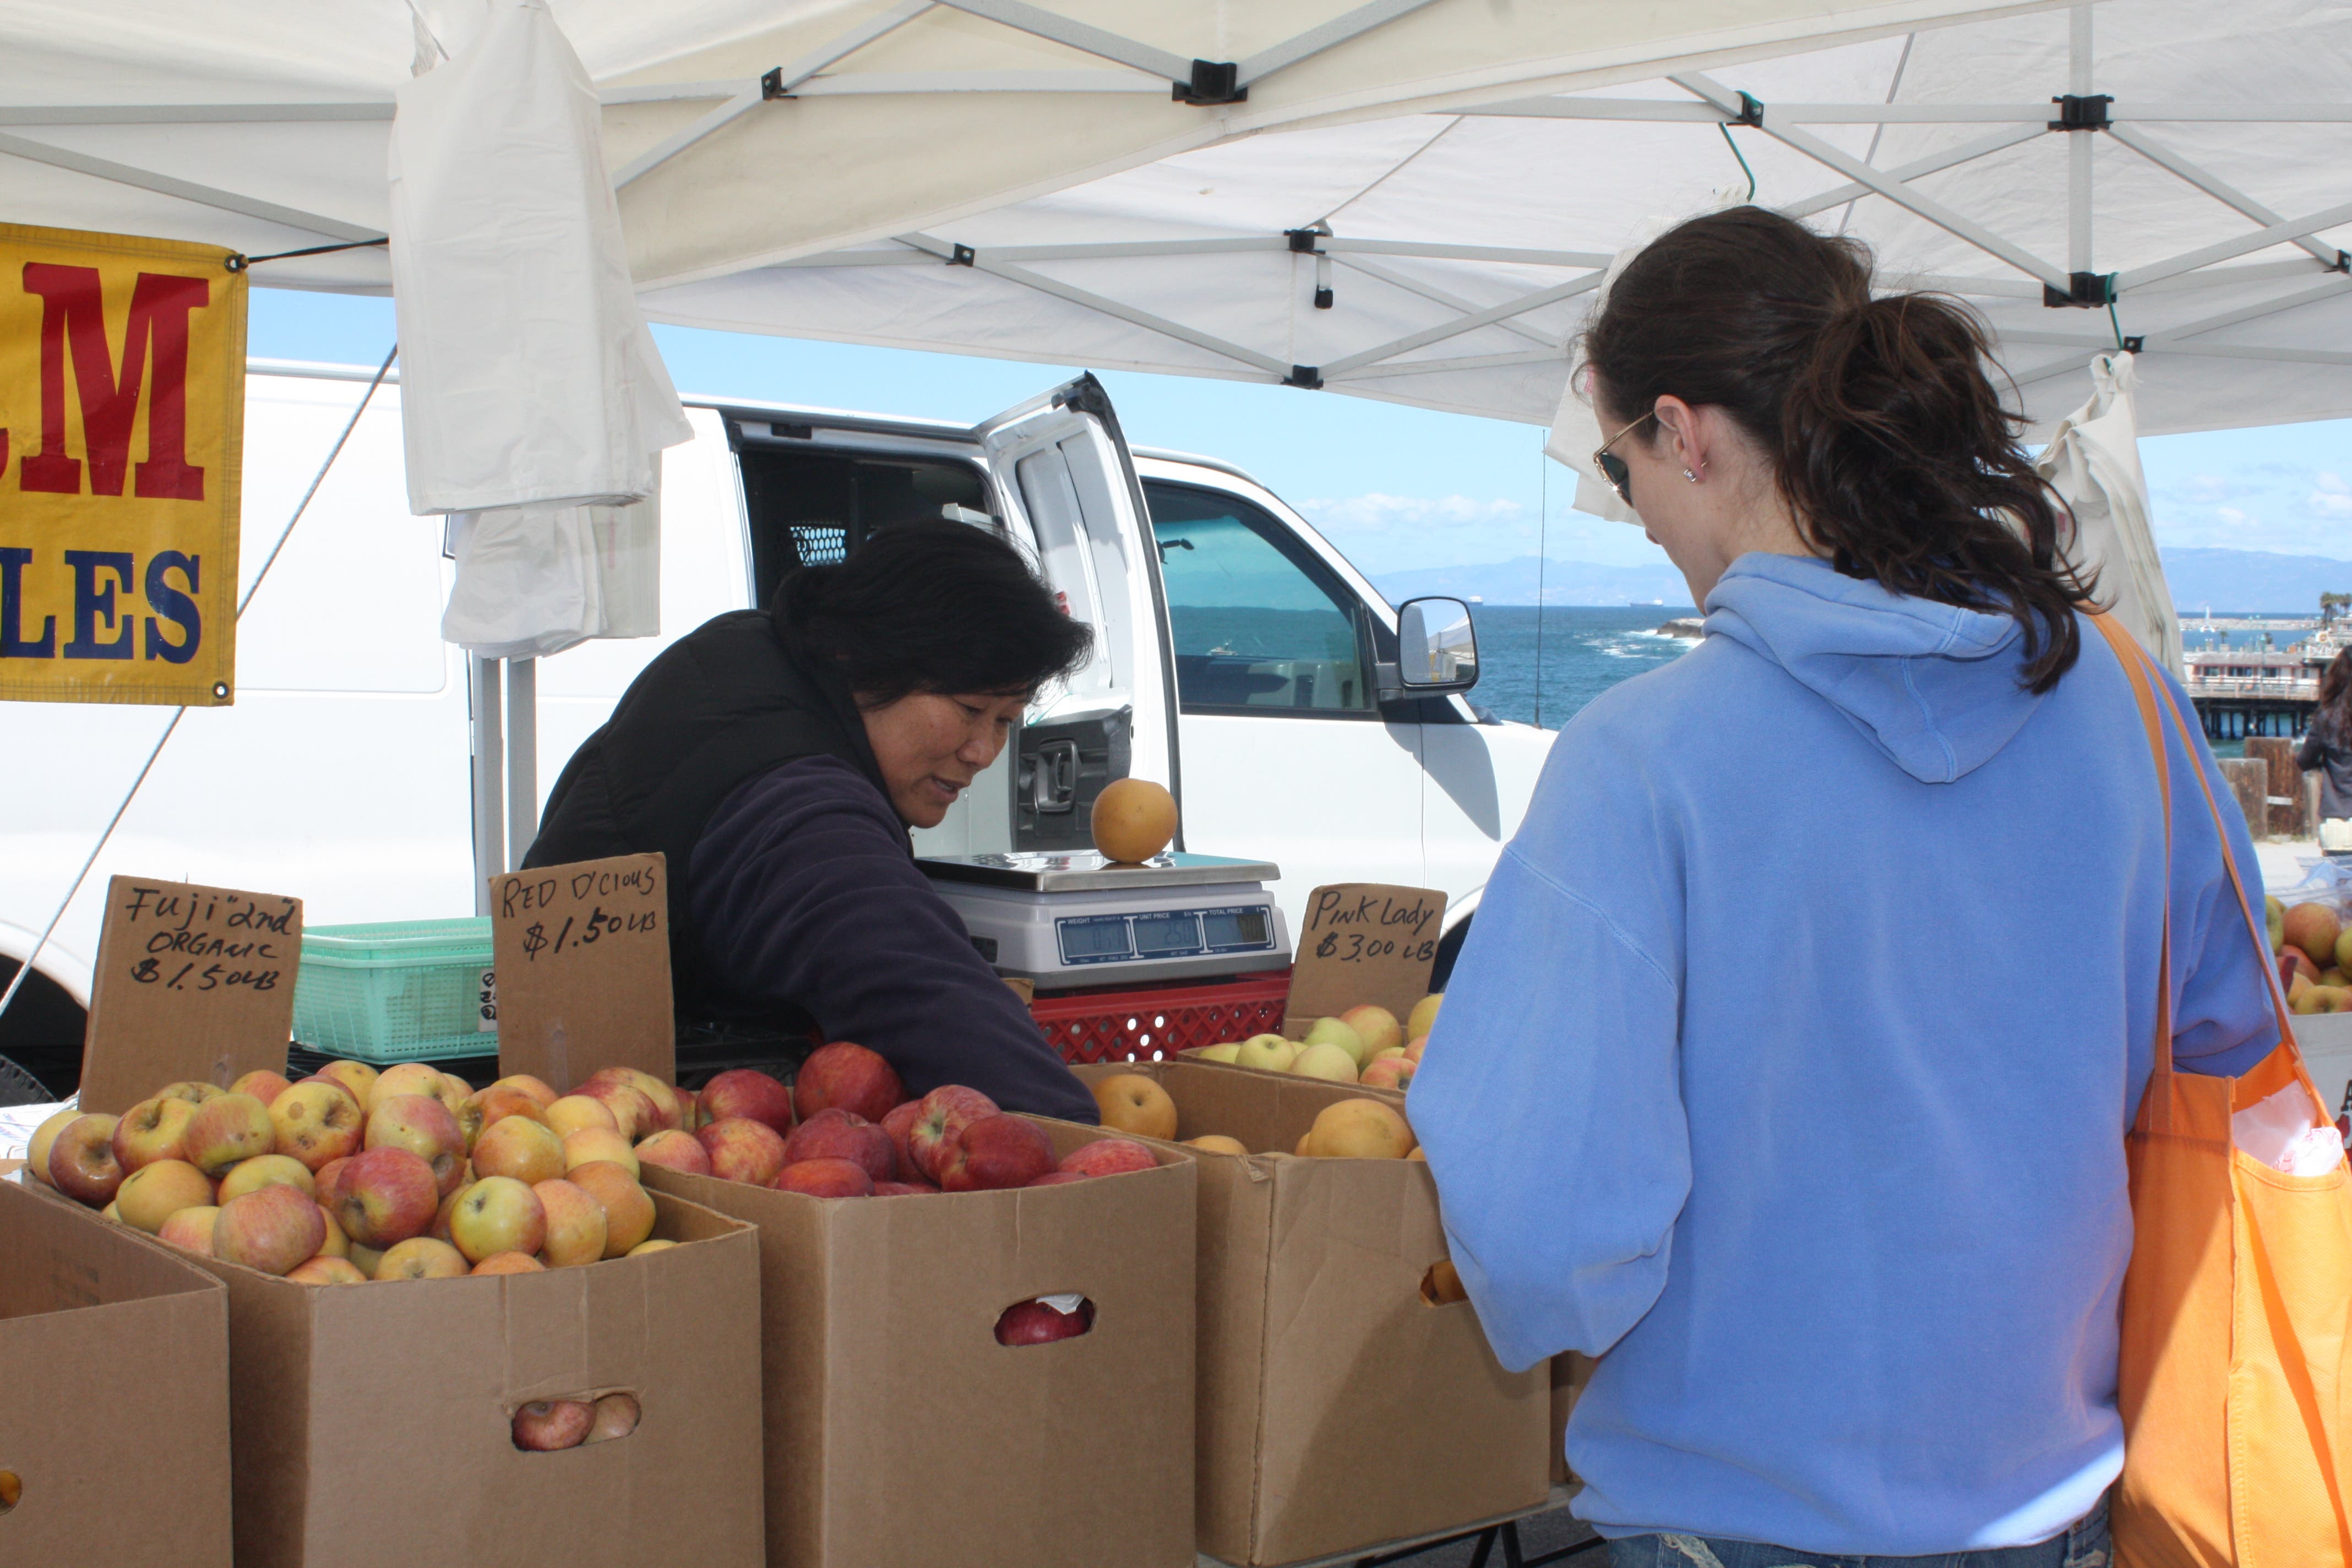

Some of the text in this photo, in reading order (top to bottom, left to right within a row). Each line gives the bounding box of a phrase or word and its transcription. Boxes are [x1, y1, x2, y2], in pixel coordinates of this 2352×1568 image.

[0, 262, 210, 502] M
[126, 887, 219, 931] Fuji
[503, 878, 557, 918] RED
[1380, 897, 1434, 936] Lady
[524, 907, 622, 961] $1.50
[1067, 917, 1091, 925] WEIGHT
[1316, 932, 1434, 963] $3.00 LB
